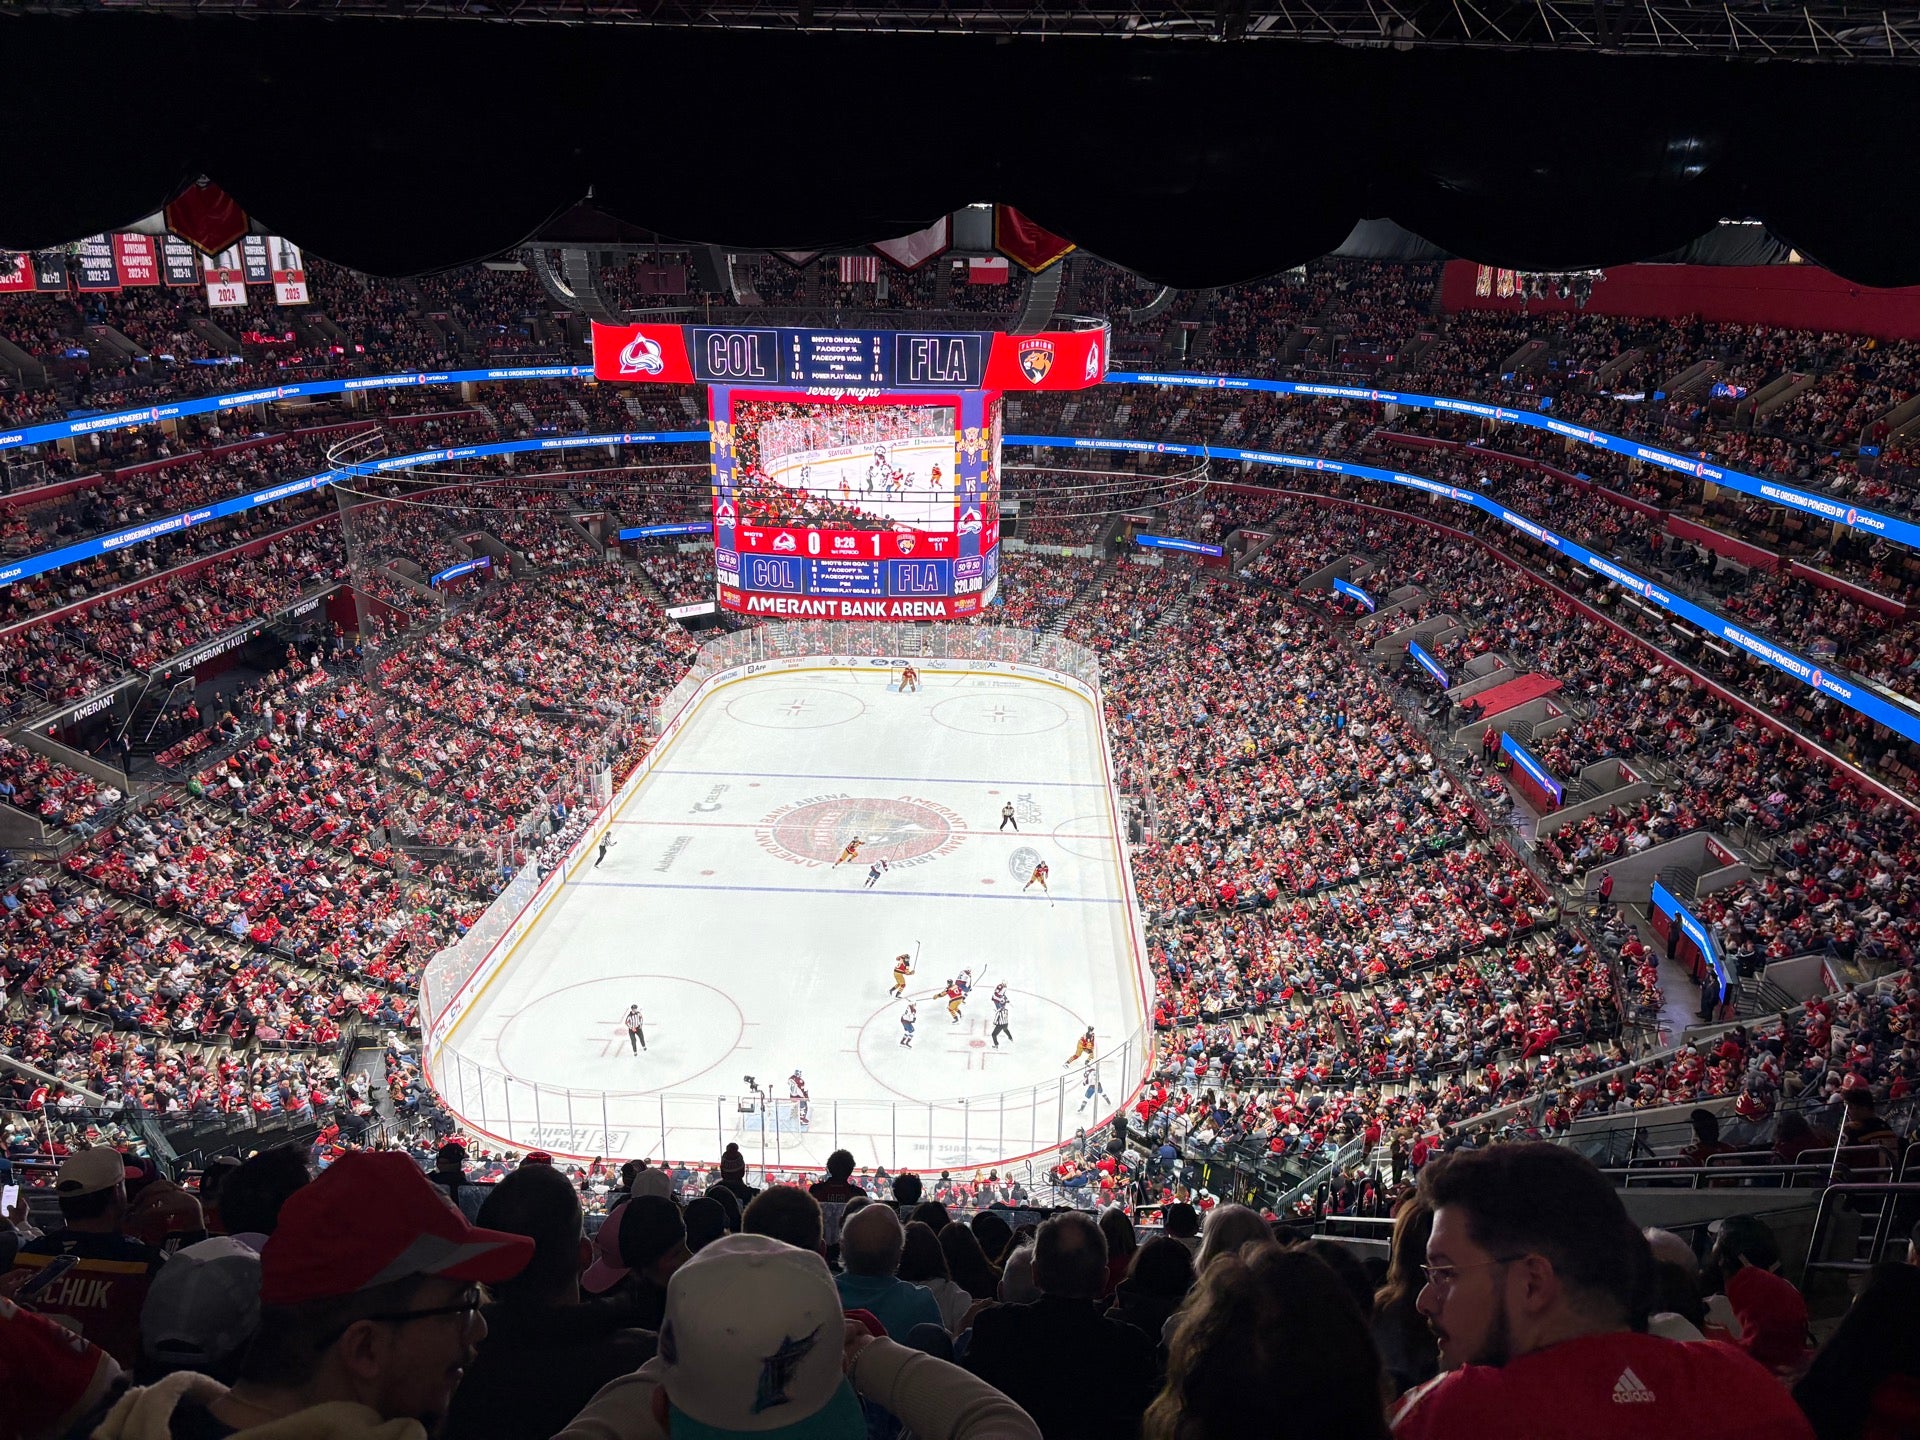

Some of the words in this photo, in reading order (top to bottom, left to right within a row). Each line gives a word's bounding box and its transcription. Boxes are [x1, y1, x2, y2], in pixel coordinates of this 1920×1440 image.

[124, 243, 148, 254] DIVISION
[165, 245, 193, 255] CONFERENCE
[244, 246, 266, 256] CONFERENCE
[122, 256, 152, 266] CHAMPIONS
[167, 256, 193, 267] CHAMPIONS
[246, 256, 267, 266] CHAMPIONS
[87, 270, 111, 282] 2022-23
[128, 267, 150, 279] 2023-24
[172, 268, 191, 278] 2023-24
[218, 288, 236, 302] 2024
[284, 288, 300, 300] 2025
[873, 337, 880, 345] 11
[1020, 340, 1052, 350] FLORIDA
[708, 333, 765, 377] COL
[910, 338, 967, 381] FLA
[508, 369, 534, 377] ORDERING
[535, 368, 560, 376] POWERED
[344, 380, 362, 388] MOBILE
[362, 379, 384, 387] ORDERING
[384, 378, 407, 386] POWERED
[1184, 377, 1208, 385] POWERED
[806, 386, 845, 401] Jersey
[1314, 386, 1338, 395] ORDERING
[1339, 388, 1363, 397] POWERED
[1434, 400, 1452, 408] MOBILE
[70, 420, 92, 432] MOBILE
[91, 417, 118, 429] ORDERING
[118, 414, 140, 426] POWERED
[140, 411, 150, 422] BY
[158, 407, 179, 417] cantaloupe
[377, 461, 394, 469] MOBILE
[416, 454, 436, 463] POWERED
[1257, 454, 1282, 462] ORDERING
[1283, 456, 1305, 465] POWERED
[1637, 447, 1652, 460] MOBILE
[1652, 451, 1671, 465] ORDERING
[1670, 457, 1689, 470] POWERED
[1689, 463, 1695, 472] BY
[1702, 468, 1723, 480] cantaloupe
[720, 472, 728, 485] VS
[965, 478, 977, 494] VS
[1394, 474, 1410, 484] MOBILE
[1428, 481, 1444, 492] POWERED
[1444, 486, 1450, 495] BY
[1760, 484, 1781, 498] MOBILE
[1780, 490, 1808, 508] ORDERING
[1808, 498, 1836, 516] POWERED
[1836, 507, 1846, 519] BY
[1856, 515, 1885, 530] cantaloupe
[102, 536, 124, 549] MOBILE
[124, 528, 151, 542] ORDERING
[151, 521, 175, 535] POWERED
[175, 518, 182, 528] BY
[190, 510, 211, 522] cantaloupe
[808, 532, 820, 555] 0
[834, 536, 856, 548] 9:26
[871, 534, 880, 556] 1
[934, 542, 943, 552] 11
[958, 563, 966, 572] 50
[972, 561, 980, 569] 50
[753, 559, 794, 588] COL
[899, 564, 938, 591] FLA
[954, 576, 983, 595] $20,800
[294, 598, 320, 618] AMERANT
[747, 596, 838, 616] AMERANT
[841, 600, 887, 617] BANK
[891, 601, 947, 617] ARENA
[178, 660, 192, 672] THE
[192, 642, 225, 666] AMERANT
[226, 633, 248, 650] VAULT
[1723, 626, 1745, 644] MOBILE
[1744, 636, 1772, 659] ORDERING
[1772, 650, 1801, 674] POWERED
[1800, 665, 1810, 678] BY
[1822, 678, 1852, 699] cantaloupe
[73, 693, 116, 723] AMERANT
[794, 793, 851, 807] ARENA
[760, 804, 796, 824] BANK
[898, 796, 968, 830] AMERANT
[754, 829, 823, 868] AMERANT
[934, 835, 967, 856] BANK
[653, 836, 689, 872] AutoNation
[890, 854, 936, 869] AREN
[36, 1278, 114, 1309] CHUK
[1612, 1390, 1656, 1404] adidas
